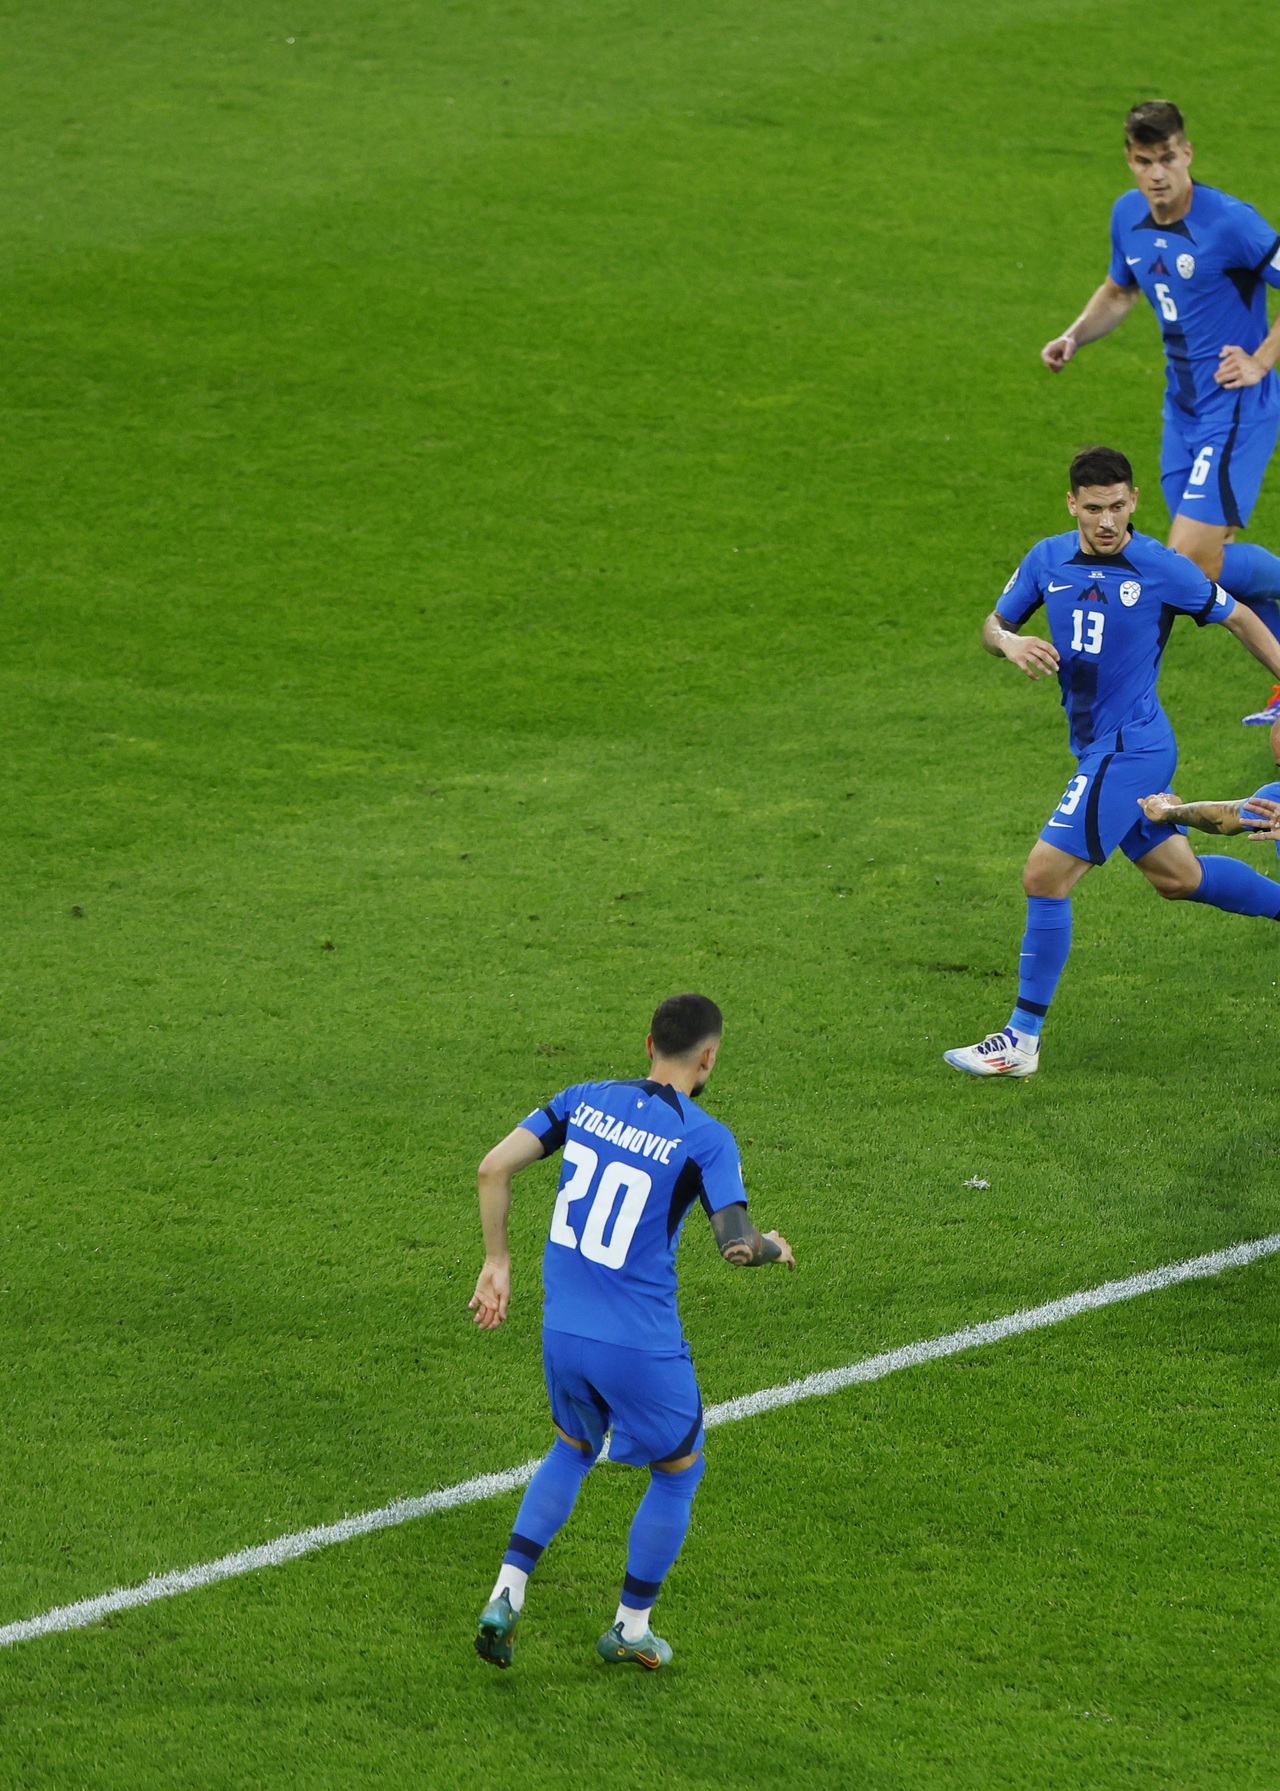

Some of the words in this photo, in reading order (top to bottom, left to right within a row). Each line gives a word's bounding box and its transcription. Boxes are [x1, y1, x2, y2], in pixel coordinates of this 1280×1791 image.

[1154, 283, 1178, 322] 6
[1189, 446, 1214, 486] 6
[1071, 609, 1105, 655] 13
[1056, 775, 1088, 815] 3
[569, 1101, 682, 1165] STOJANOVIĆ
[550, 1139, 652, 1270] 20
